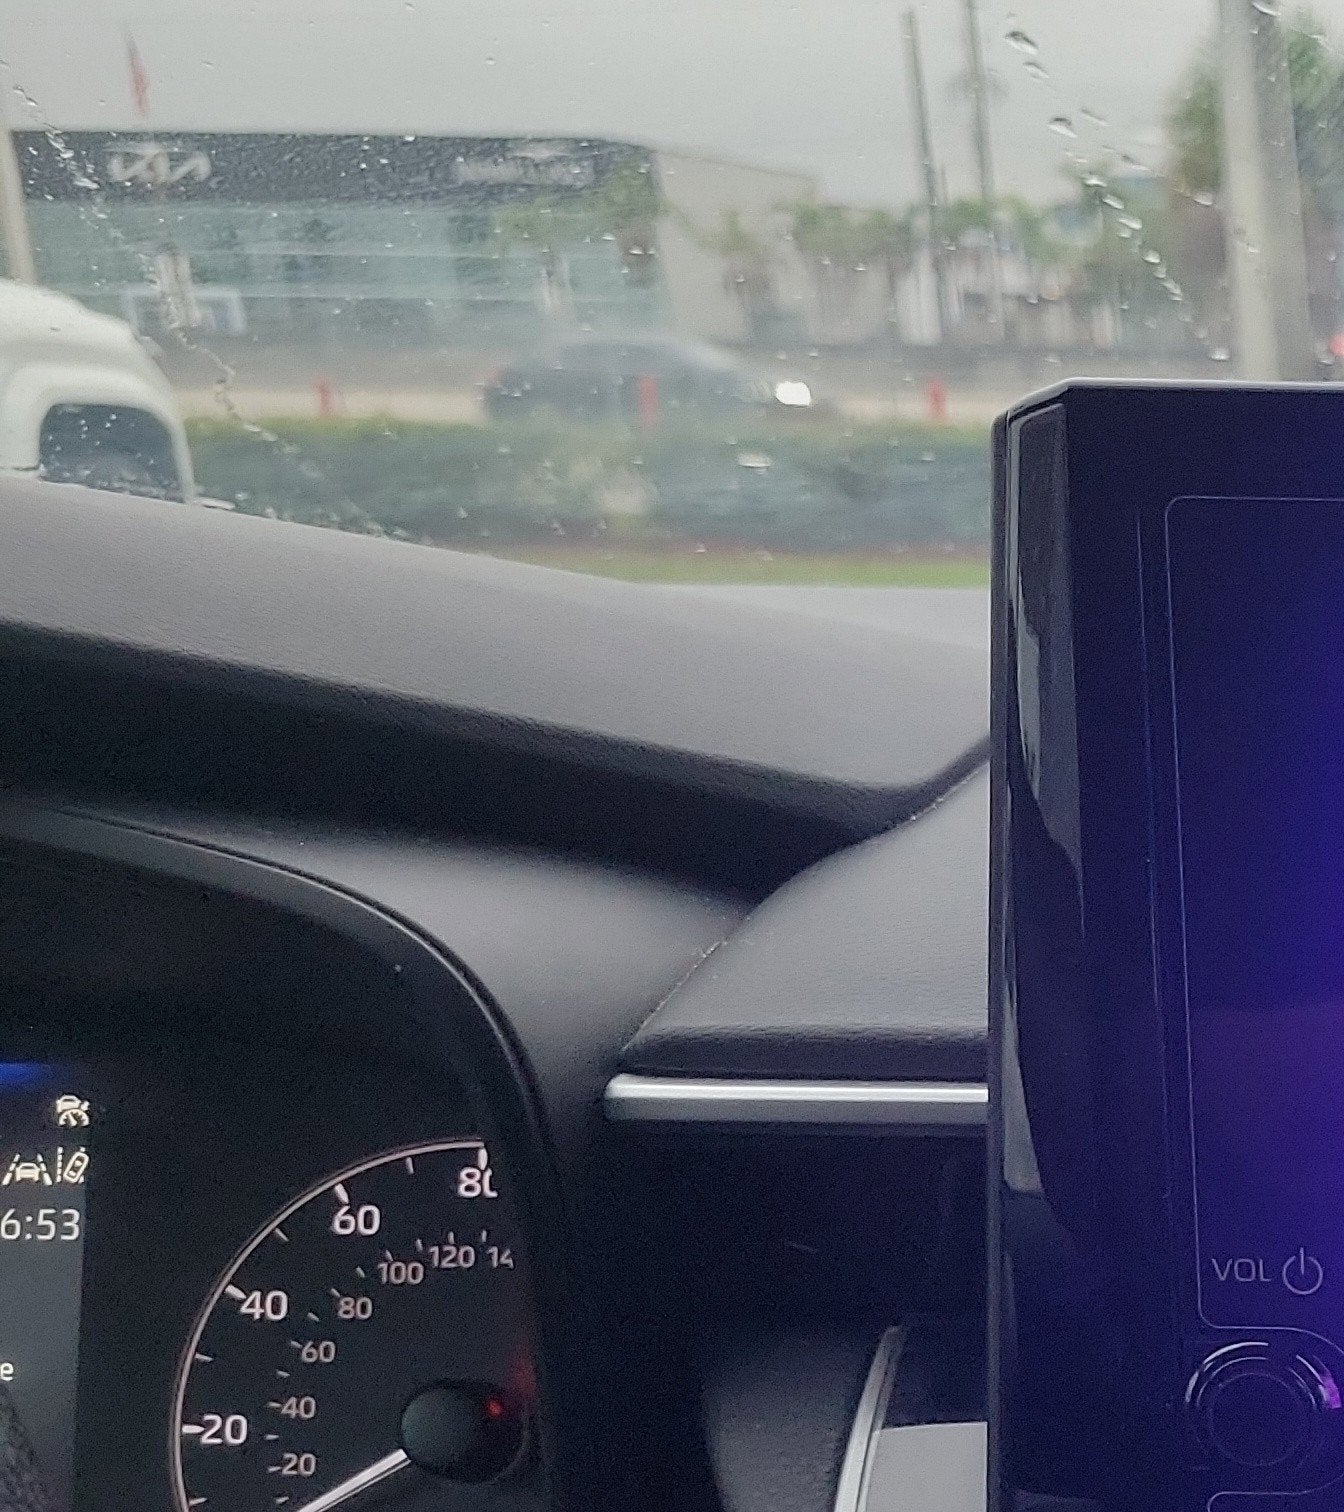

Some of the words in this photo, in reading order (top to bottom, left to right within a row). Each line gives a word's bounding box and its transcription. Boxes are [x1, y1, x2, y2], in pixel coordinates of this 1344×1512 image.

[332, 1205, 380, 1235] 60
[429, 1245, 475, 1268] 120
[487, 1246, 515, 1269] 14
[378, 1261, 424, 1284] 100
[1211, 1257, 1271, 1283] VOL
[242, 1290, 288, 1321] 40
[338, 1297, 373, 1320] 80
[301, 1340, 336, 1363] 60
[281, 1396, 316, 1419] 40
[200, 1414, 248, 1445] 20
[282, 1452, 316, 1476] 20
